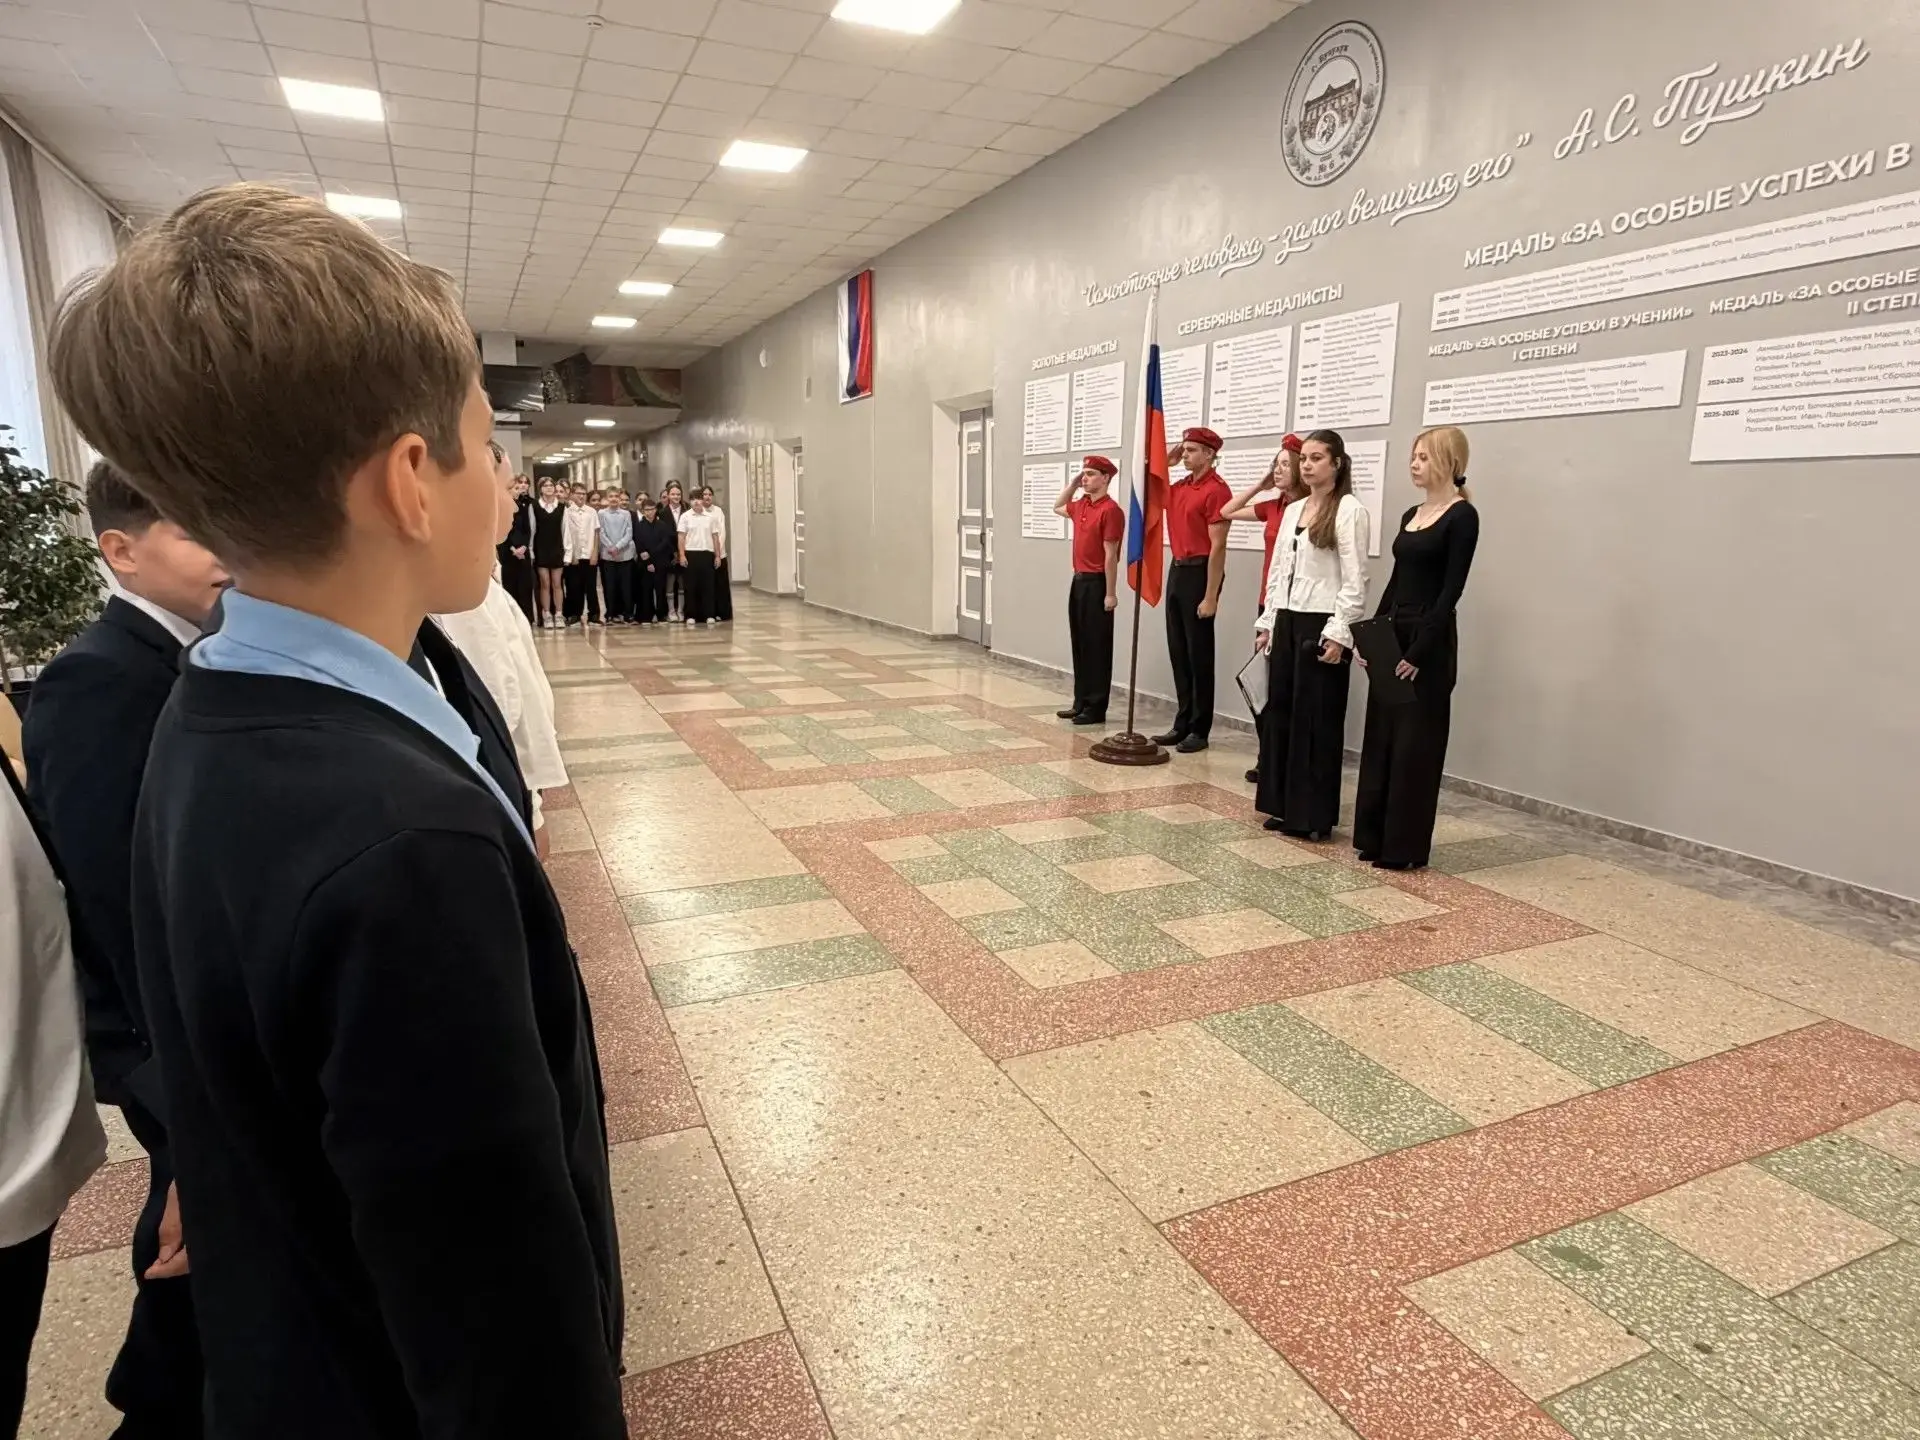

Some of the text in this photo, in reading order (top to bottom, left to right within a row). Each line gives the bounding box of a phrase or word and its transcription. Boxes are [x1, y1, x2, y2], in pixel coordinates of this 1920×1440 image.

[1184, 233, 1263, 278] человека
[1275, 210, 1344, 266] залог
[1348, 172, 1460, 227] величия
[1653, 37, 1873, 146] Пушкин
[1464, 143, 1911, 268] МЕДАЛЬ «ЗА ОСОБЫЕ УСПЕХИ В
[1177, 283, 1343, 336] СЕРЕБРЯНЫЕ МЕДАЛИСТЫ
[1709, 267, 1919, 315] МЕДАЛЬ «ЗА ОСОБЫЕ
[1863, 292, 1920, 313] СТЕП
[1032, 339, 1119, 371] ЗОЛОТЫЕ МЕДАЛИСТЫ
[1428, 340, 1474, 357] МЕДАЛЬ
[1498, 326, 1551, 348] ОСОБЫЕ
[1552, 318, 1606, 340] УСПЕХИ
[1609, 315, 1621, 331] В
[1622, 306, 1694, 329] УЧЕНИИ»
[1519, 341, 1579, 361] СТЕПЕНИ
[1703, 409, 1739, 419] 2025-2026
